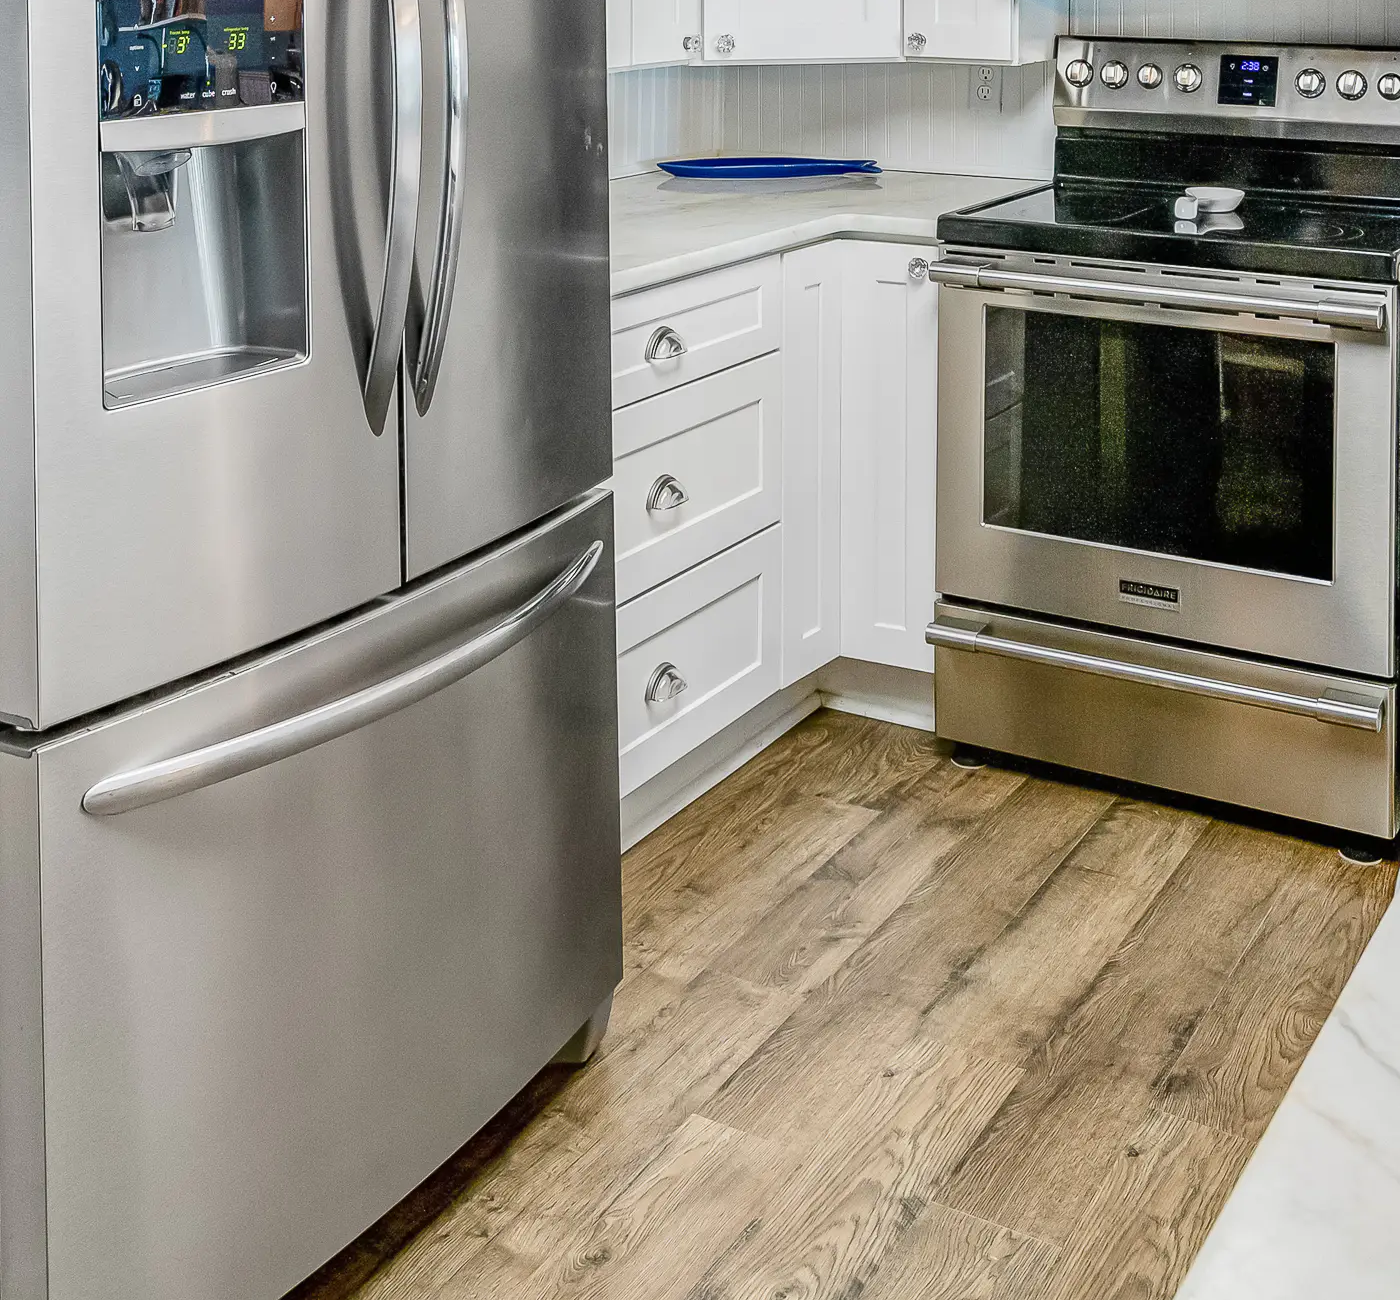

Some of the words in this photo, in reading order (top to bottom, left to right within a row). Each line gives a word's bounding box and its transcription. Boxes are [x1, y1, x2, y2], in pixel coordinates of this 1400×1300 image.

[228, 32, 246, 50] 33
[1241, 61, 1260, 71] 2:38
[180, 91, 196, 100] water
[202, 89, 215, 98] cube
[1121, 582, 1177, 600] FRIGIDAIRE
